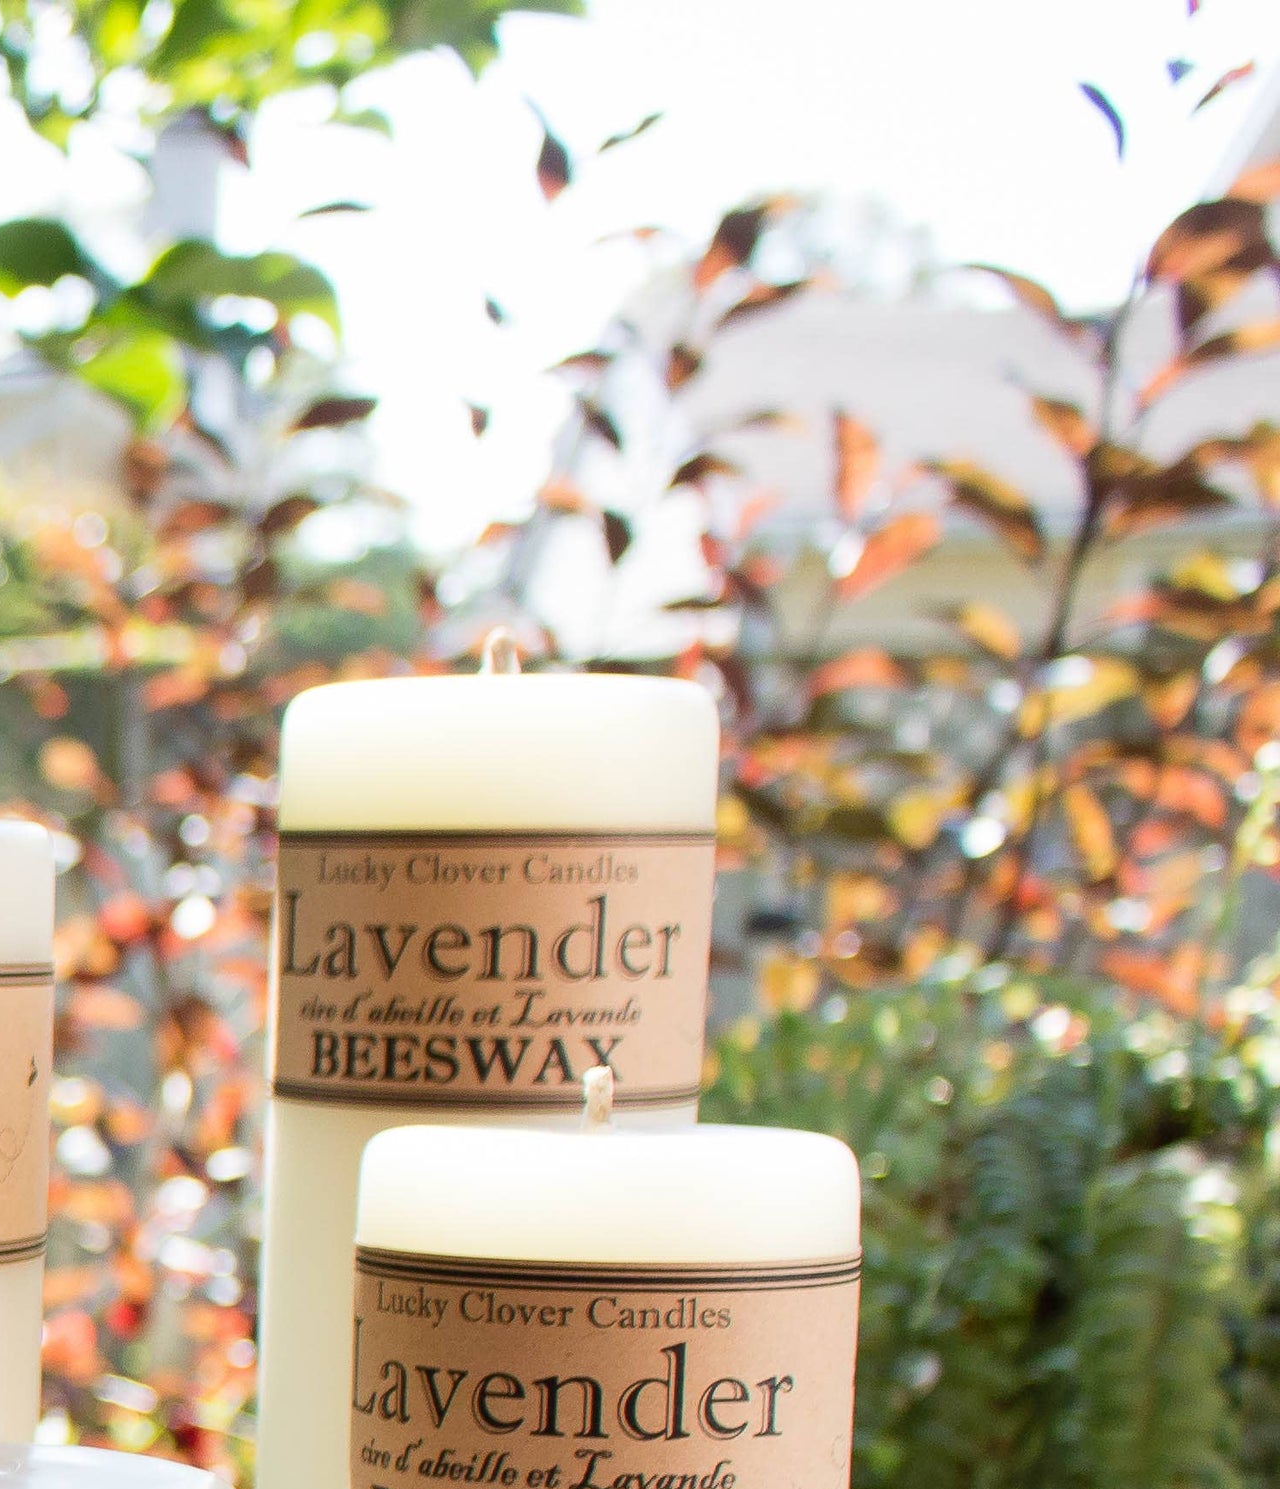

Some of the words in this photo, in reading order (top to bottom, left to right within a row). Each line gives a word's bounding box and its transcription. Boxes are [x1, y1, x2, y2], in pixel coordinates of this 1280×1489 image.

[318, 853, 395, 892] Lucky
[406, 854, 511, 884] Clover
[523, 854, 640, 885] Candles
[281, 889, 682, 983] Lavender
[310, 1030, 625, 1086] BEESWAX
[377, 1280, 448, 1328] Lucky
[460, 1291, 574, 1328] Clover
[585, 1296, 732, 1330] Candles
[351, 1314, 794, 1443] Lavender
